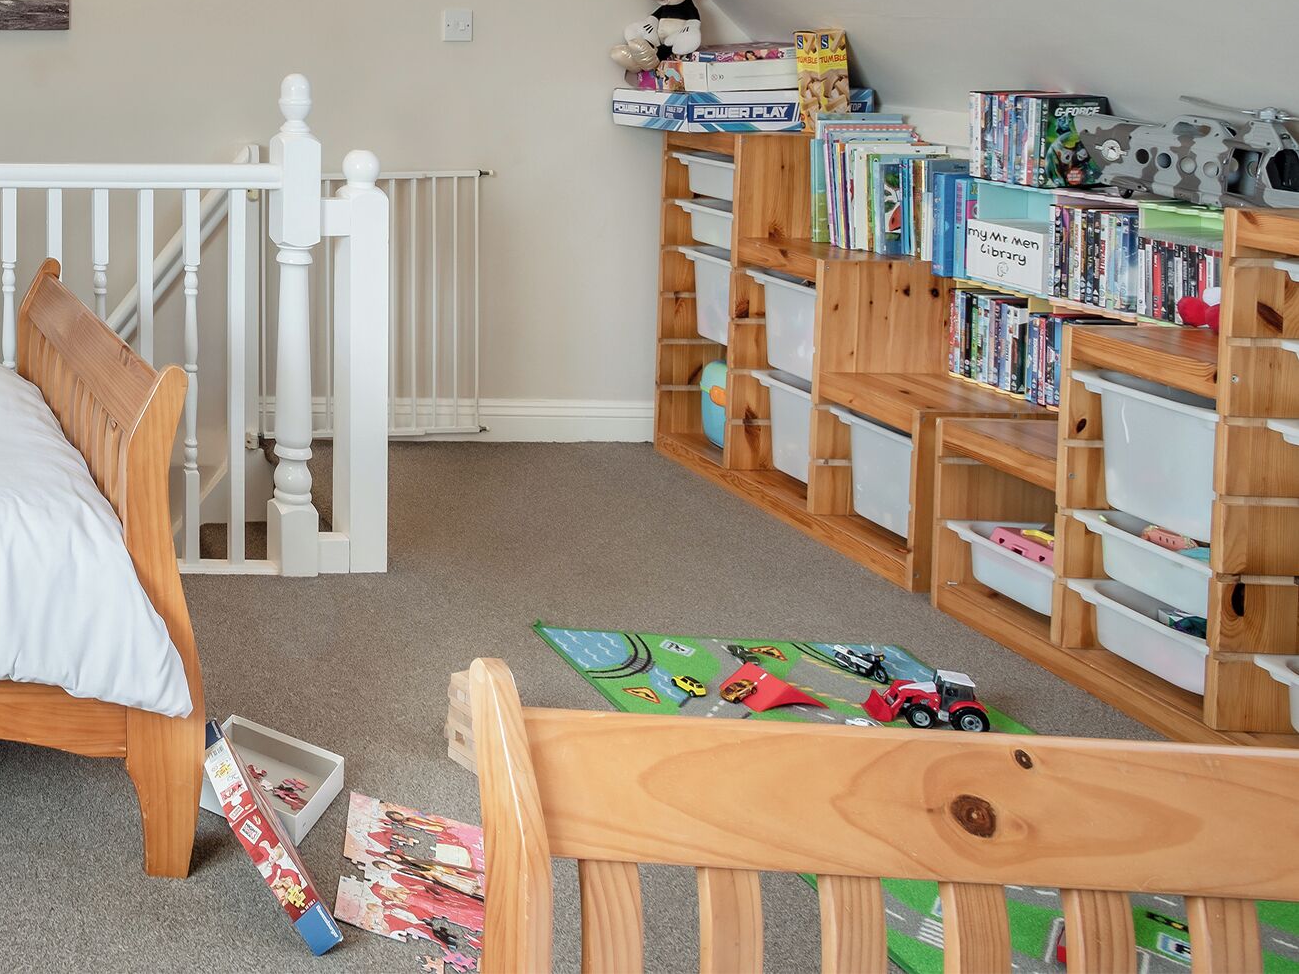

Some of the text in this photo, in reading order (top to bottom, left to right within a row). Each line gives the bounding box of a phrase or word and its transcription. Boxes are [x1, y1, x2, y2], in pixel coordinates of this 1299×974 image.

[797, 56, 818, 64] TUMBLE
[819, 54, 847, 63] TUMBLE
[614, 102, 658, 116] POWER PLAY
[694, 106, 788, 119] POWER PLAY
[1055, 107, 1100, 117] G-FORCE
[968, 227, 987, 242] my
[989, 232, 1008, 243] Mr
[1011, 236, 1039, 251] Men
